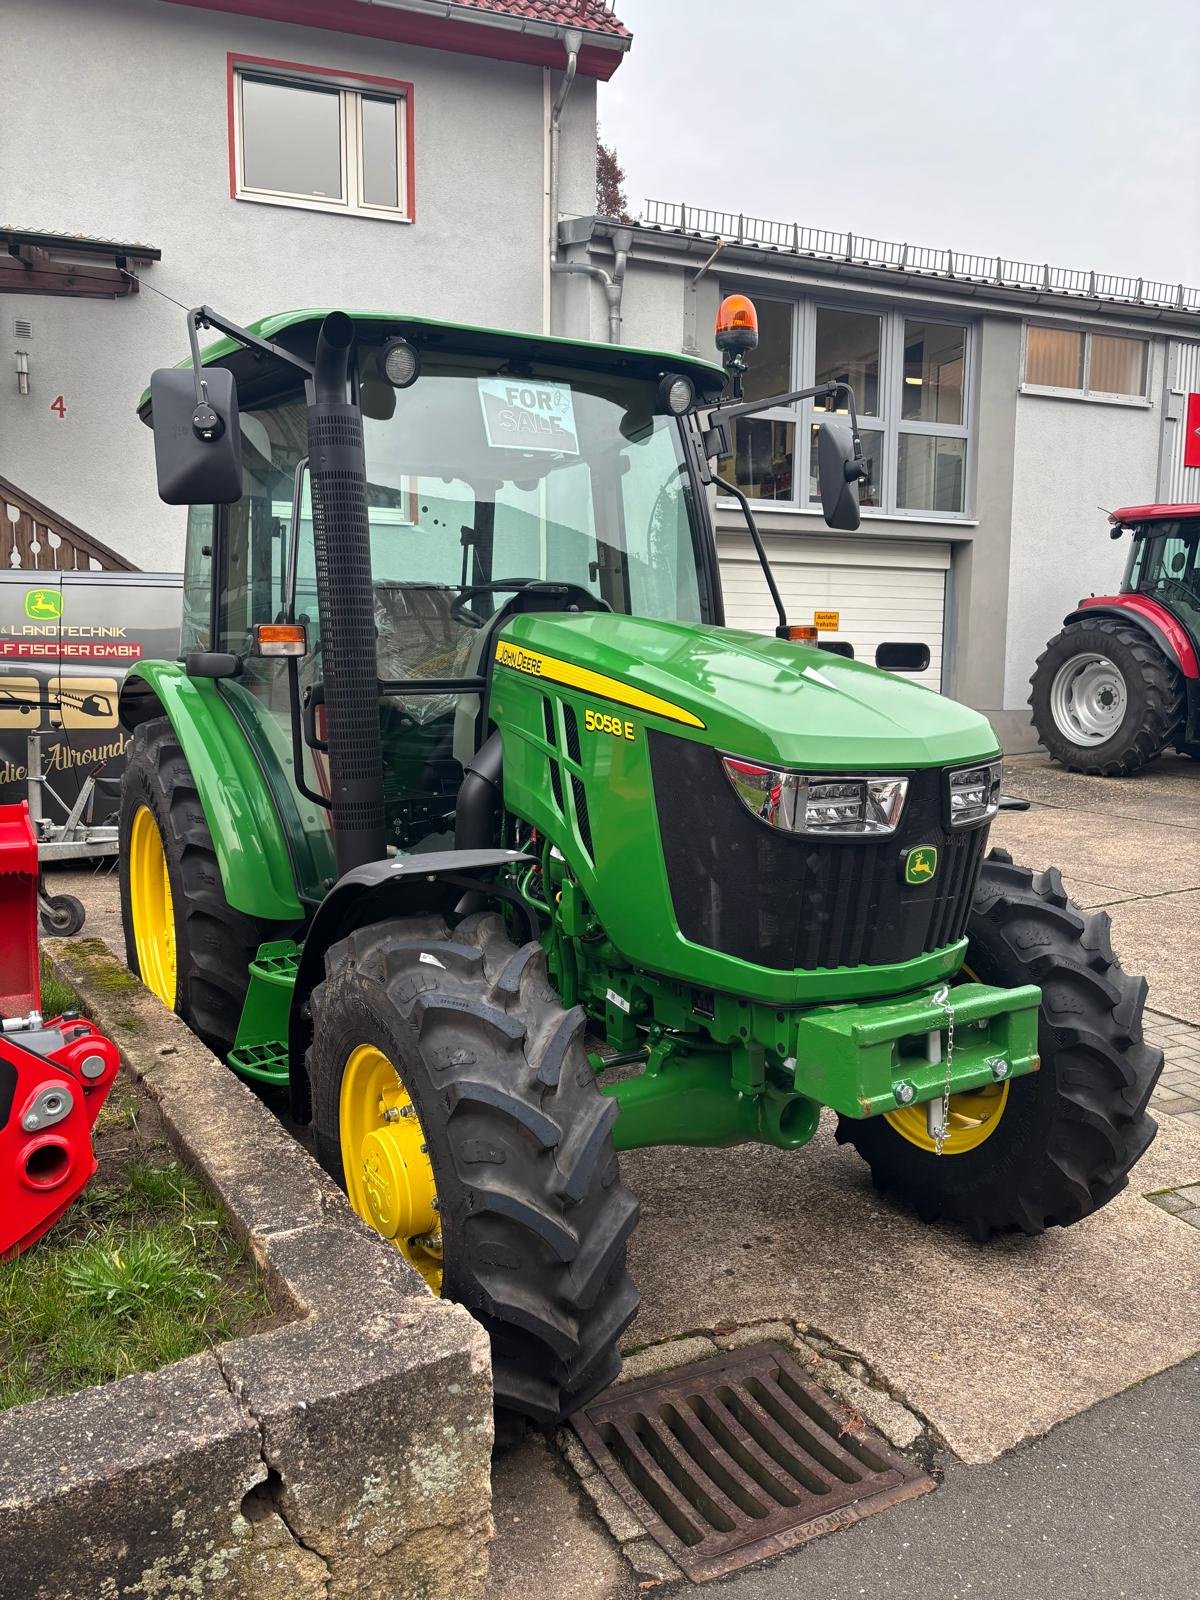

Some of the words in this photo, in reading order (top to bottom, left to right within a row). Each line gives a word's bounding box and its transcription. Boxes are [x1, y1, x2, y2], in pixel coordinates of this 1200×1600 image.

[51, 396, 66, 418] 4
[505, 387, 553, 411] FOR
[498, 410, 565, 436] SALE
[0, 625, 8, 634] &
[10, 625, 127, 638] LANDTECHNIK
[18, 644, 90, 656] FISCHER
[93, 645, 141, 657] GMBH
[499, 646, 516, 667] JOHN
[516, 651, 542, 674] DEERE
[585, 709, 622, 736] 5058
[624, 721, 635, 740] E
[0, 760, 27, 785] die
[45, 733, 134, 777] Allround
